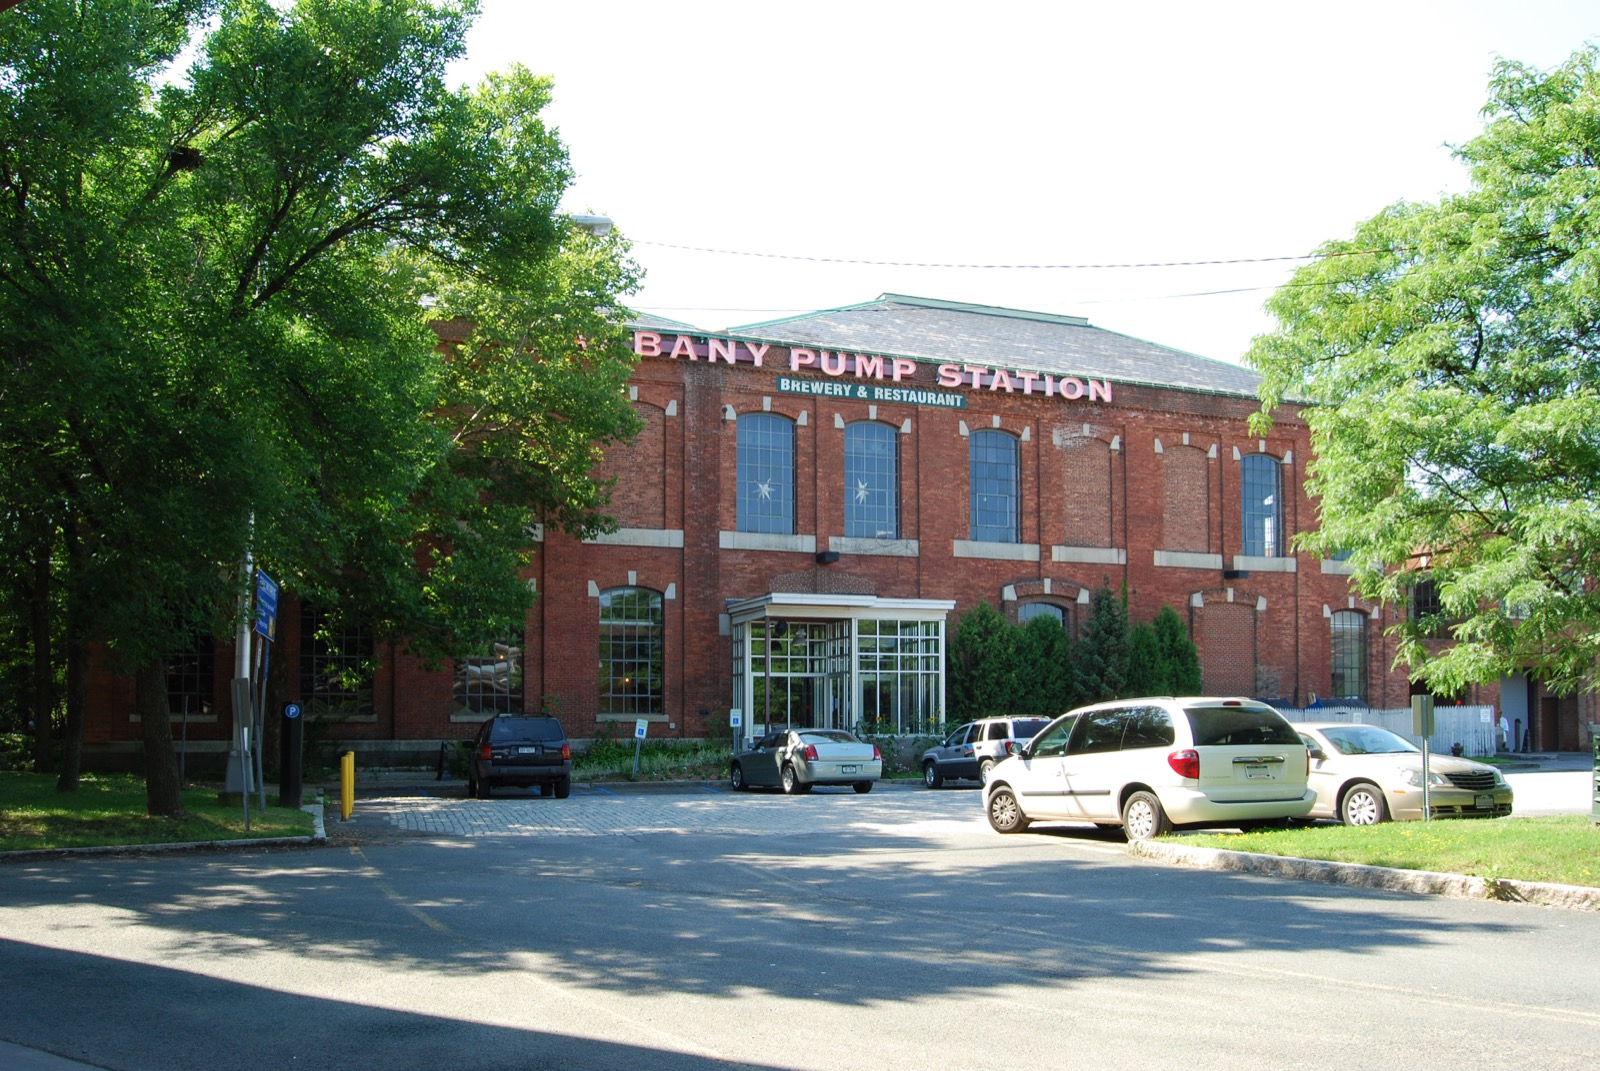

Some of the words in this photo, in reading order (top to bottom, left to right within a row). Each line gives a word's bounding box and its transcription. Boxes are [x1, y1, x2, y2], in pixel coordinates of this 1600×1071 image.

[577, 331, 769, 367] BANY
[790, 348, 917, 382] PUMP
[938, 363, 1112, 402] STATION
[780, 378, 852, 397] BREWERY
[856, 385, 868, 399] &
[874, 386, 964, 408] RESTAURANT
[289, 706, 296, 716] P
